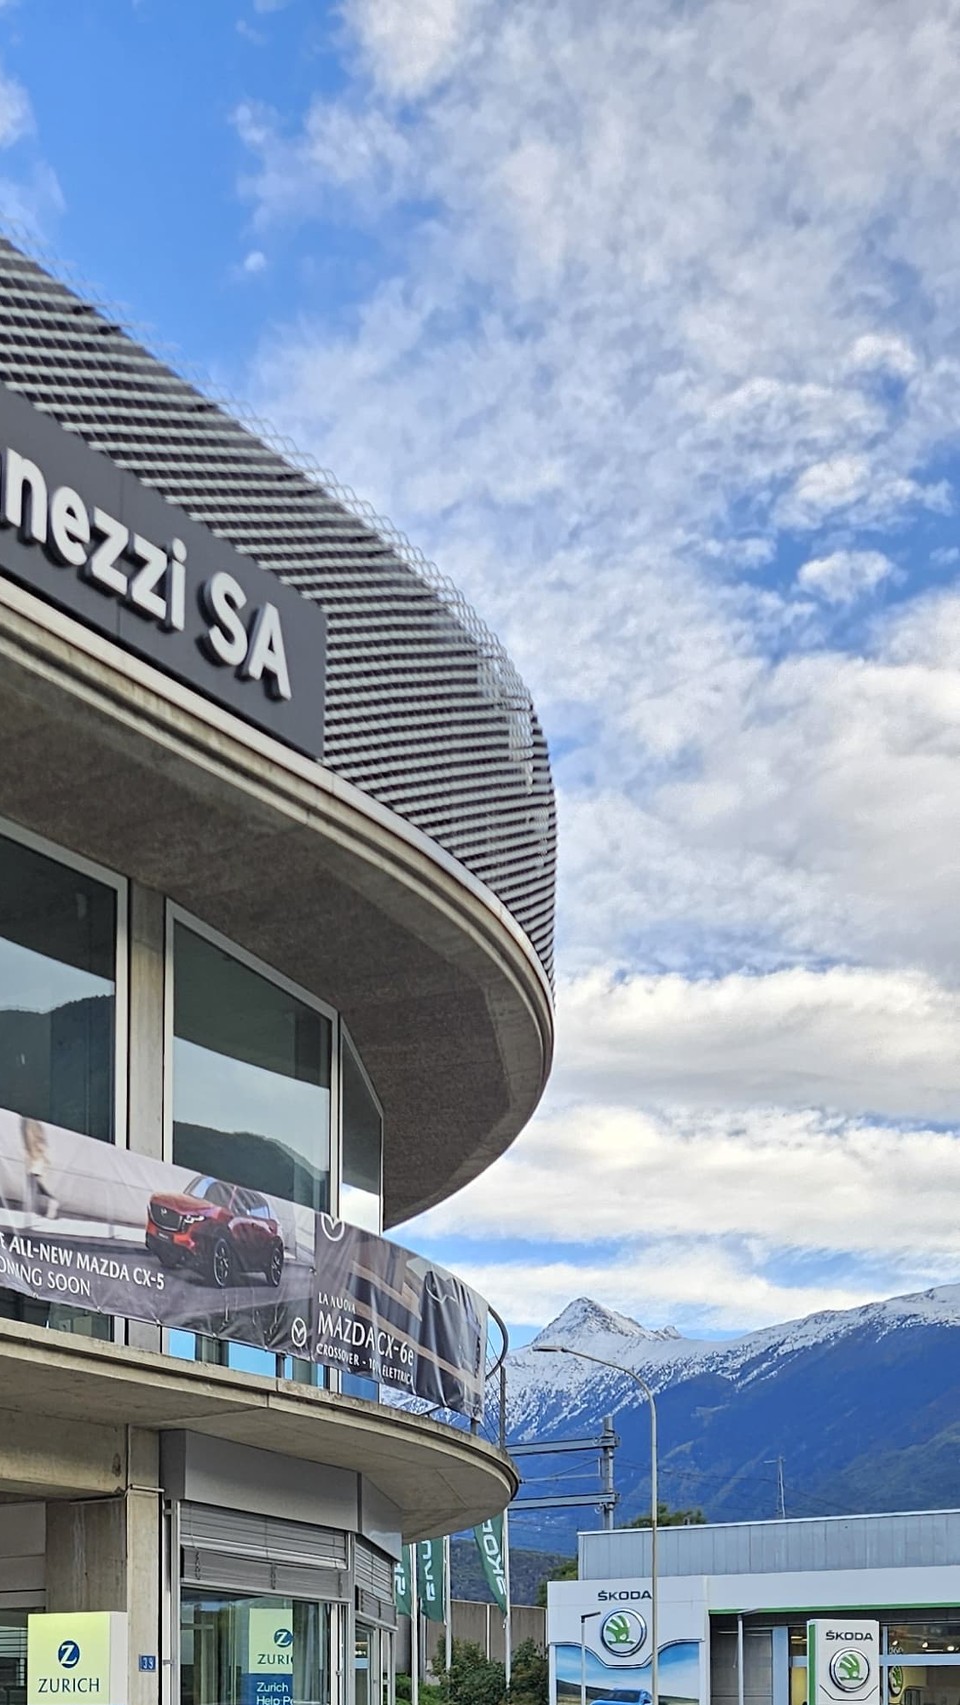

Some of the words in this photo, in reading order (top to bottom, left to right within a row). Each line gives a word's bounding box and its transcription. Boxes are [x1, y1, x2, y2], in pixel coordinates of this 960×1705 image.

[200, 570, 292, 701] SA
[8, 1235, 73, 1267] ALL-NEW
[76, 1252, 130, 1282] MAZDA
[133, 1267, 165, 1291] CX-5
[47, 1271, 91, 1297] SOON
[318, 1291, 329, 1306] LA
[317, 1310, 375, 1351] MAZDA
[377, 1331, 414, 1367] CX-6e
[257, 1653, 293, 1665] ZURI
[38, 1678, 100, 1693] ZURICH
[256, 1682, 288, 1692] Zurich
